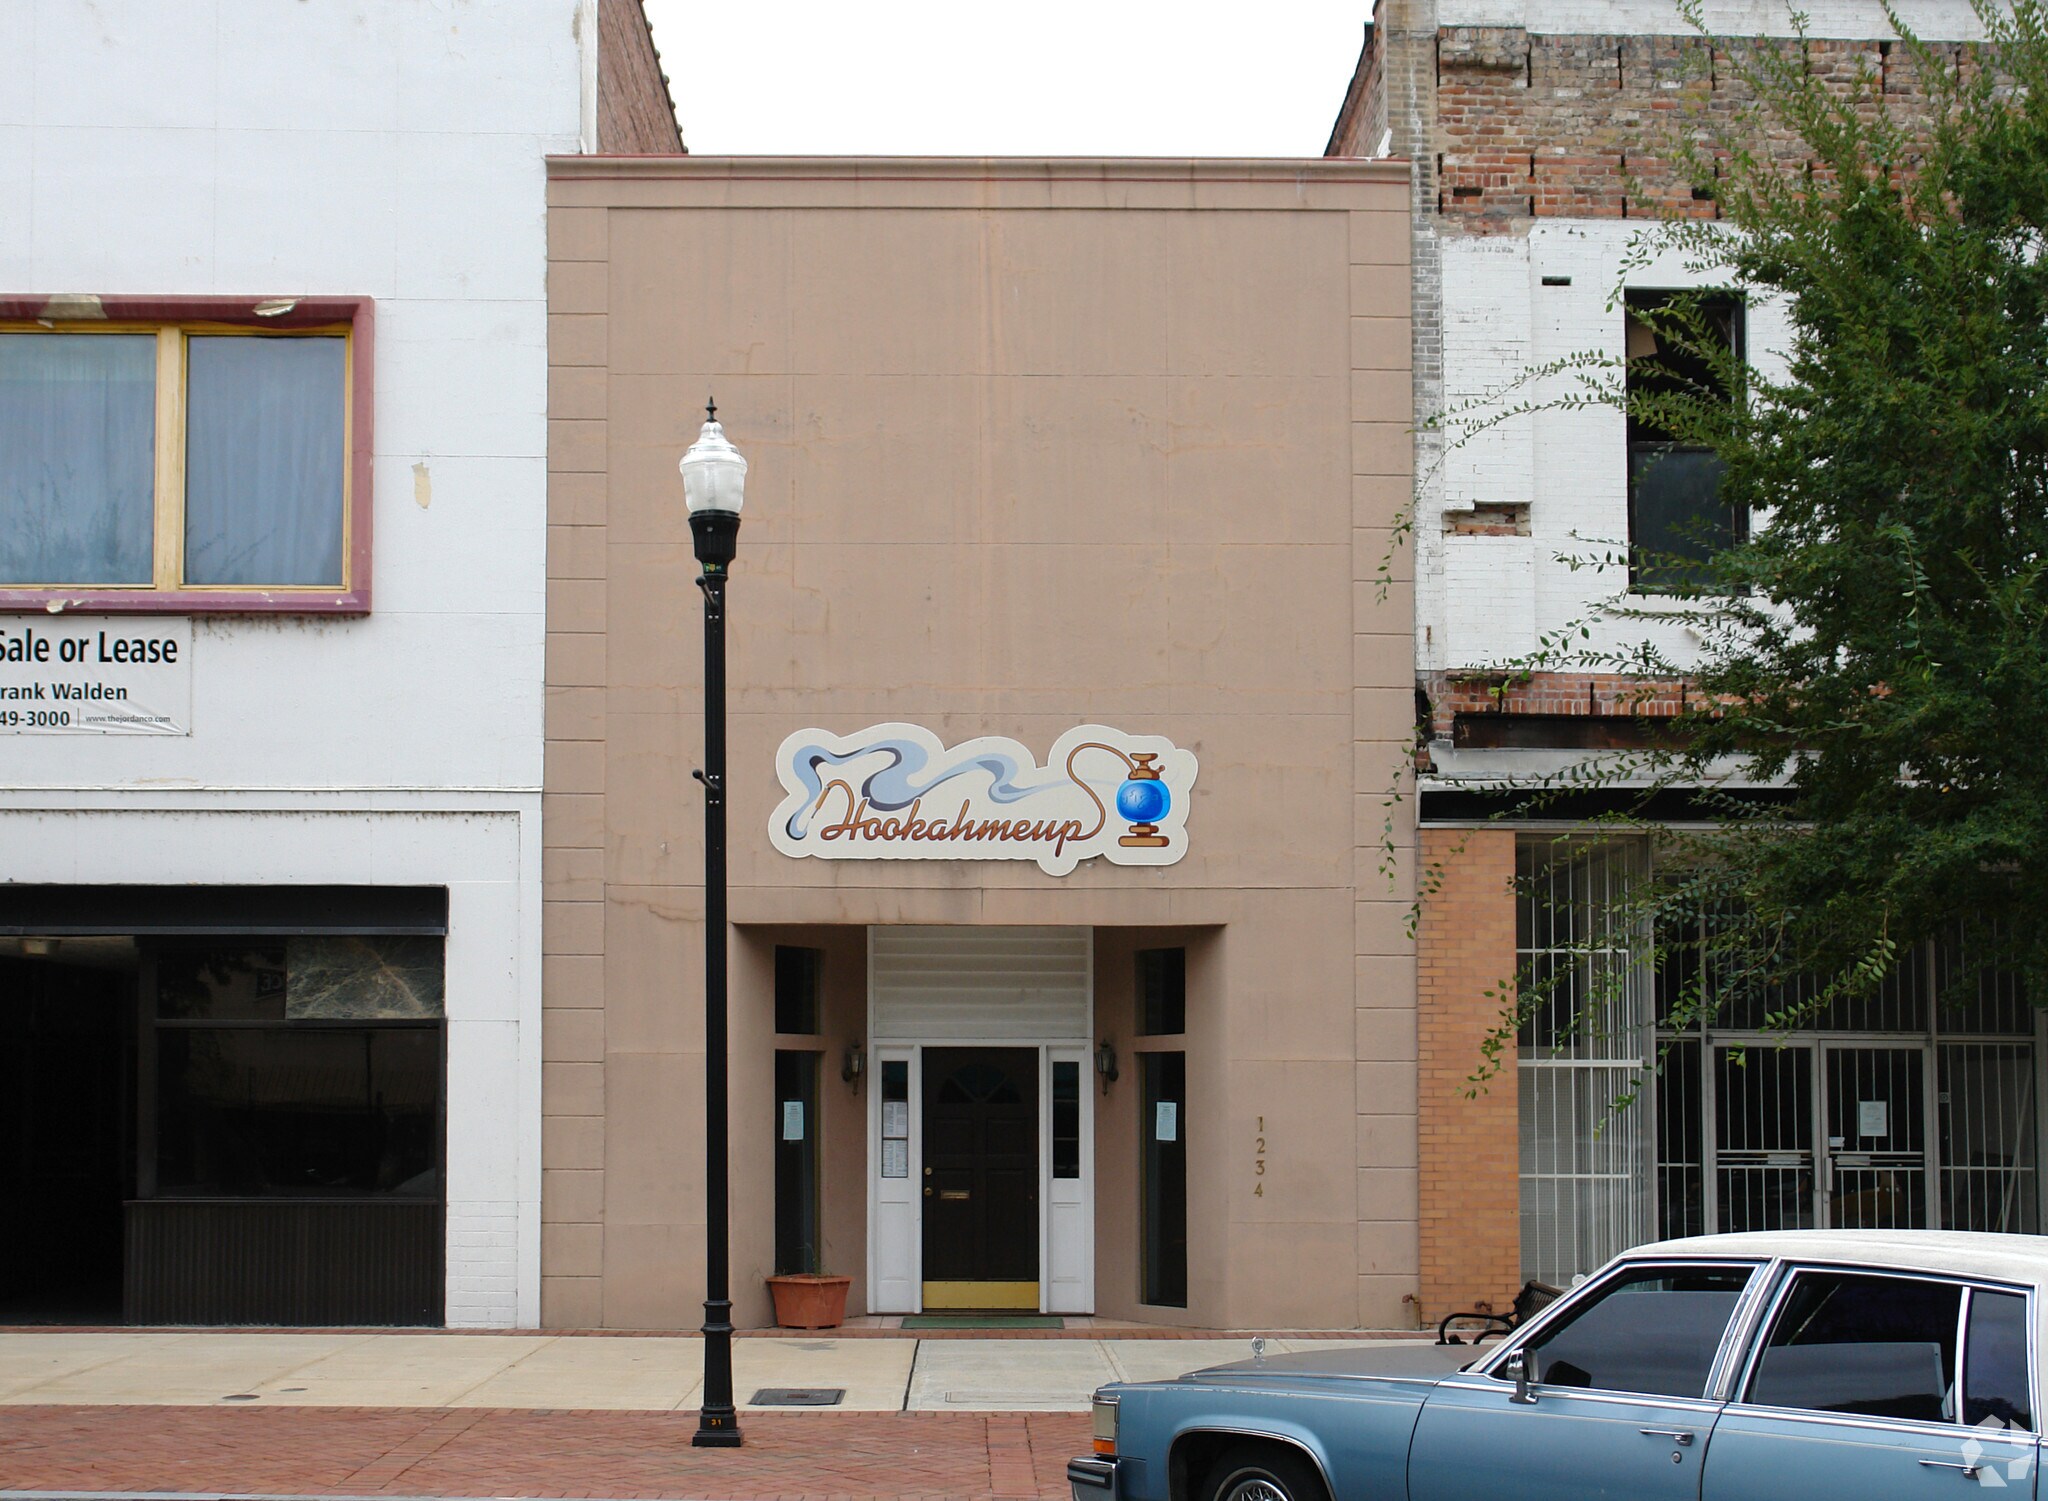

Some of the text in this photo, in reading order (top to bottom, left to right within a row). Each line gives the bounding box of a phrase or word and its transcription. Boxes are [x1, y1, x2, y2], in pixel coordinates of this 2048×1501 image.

[59, 638, 89, 663] or
[98, 631, 178, 663] Lease
[52, 682, 128, 700] Walden
[820, 797, 1090, 858] Hookahmeup
[1253, 1115, 1266, 1198] 1234
